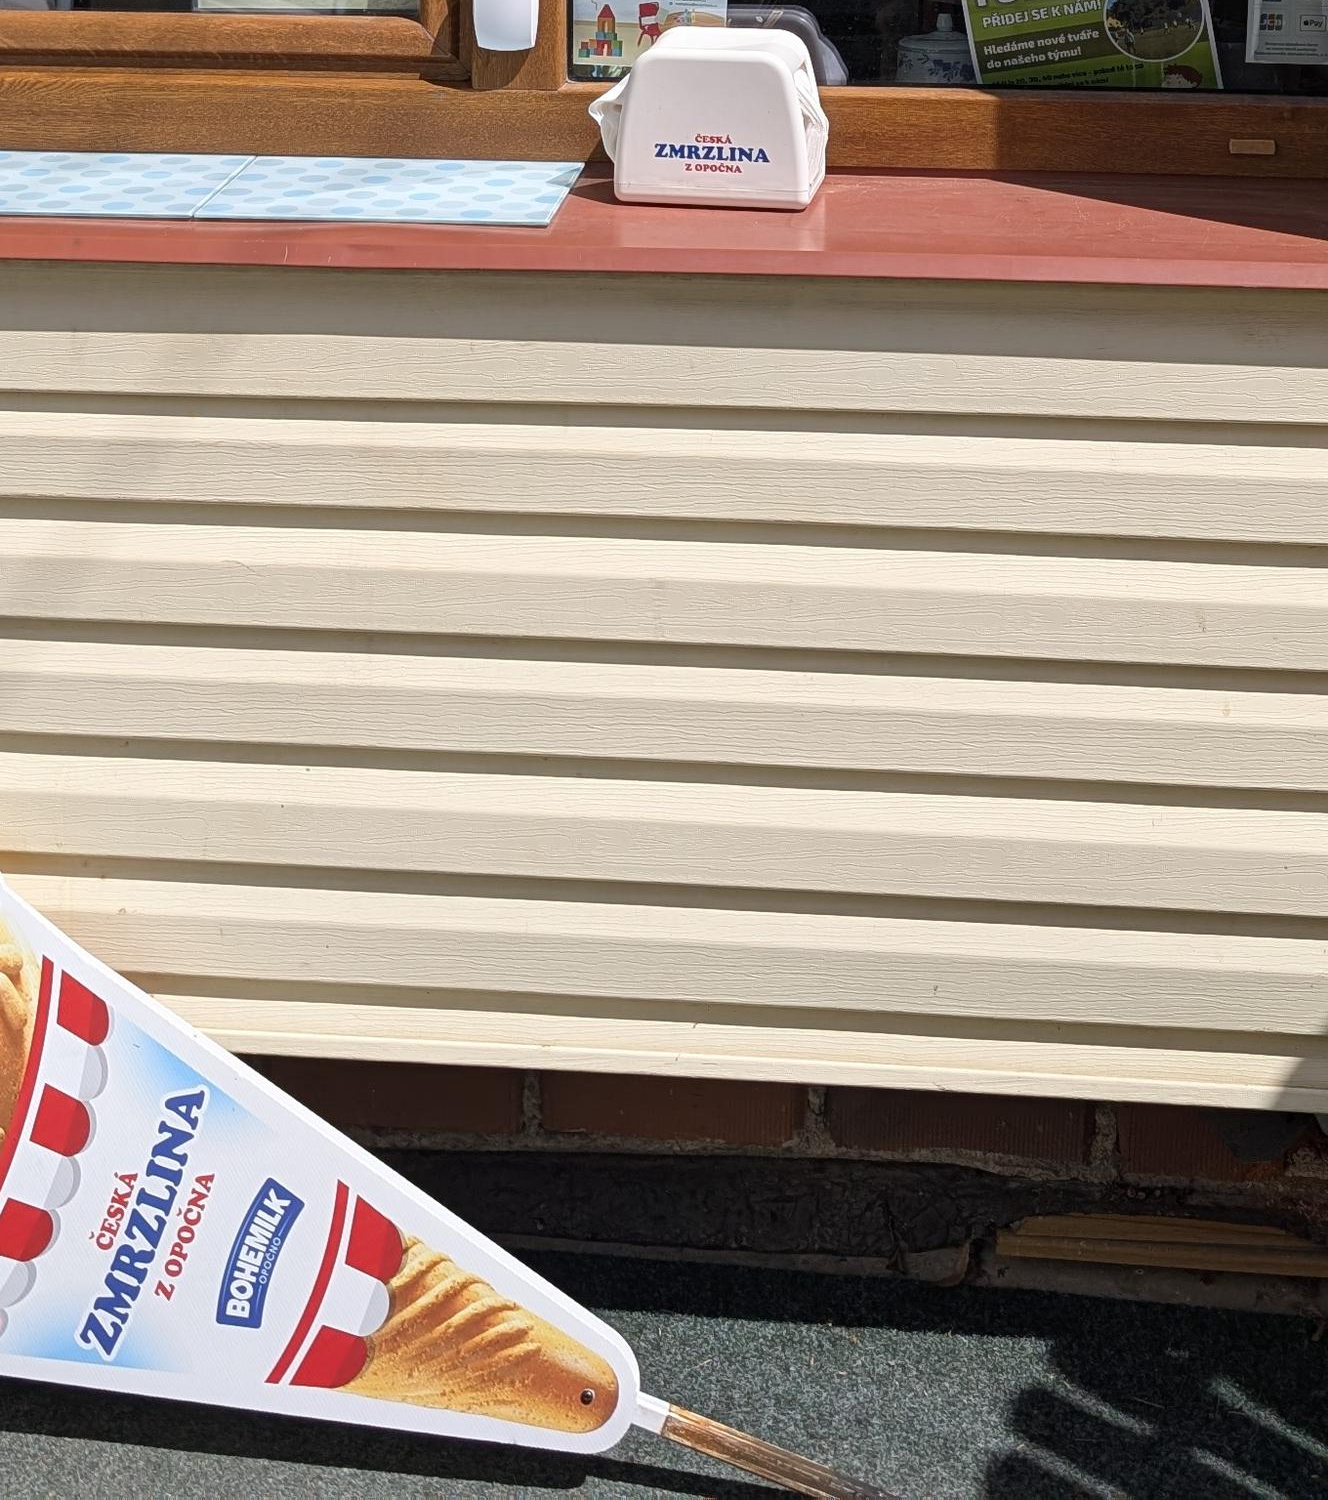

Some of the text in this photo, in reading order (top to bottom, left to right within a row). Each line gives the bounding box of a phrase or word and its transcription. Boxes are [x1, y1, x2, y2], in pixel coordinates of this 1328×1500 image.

[982, 10, 1029, 29] PŘIDEJ
[1032, 7, 1049, 21] SE
[1051, 5, 1062, 18] K
[983, 27, 1100, 57] Hledáme nové tváře
[986, 45, 1083, 70] do našeho týmu!
[654, 143, 770, 163] ZMRZLINA
[694, 133, 732, 145] ČESKÁ
[685, 162, 743, 174] Z OPOČNA
[80, 1090, 204, 1357] ZMRZLINA
[88, 1171, 139, 1251] ČESKÁ
[154, 1172, 216, 1301] Z OPOČNA
[225, 1187, 292, 1319] BOHEMILK
[259, 1236, 282, 1285] OPOČNO
